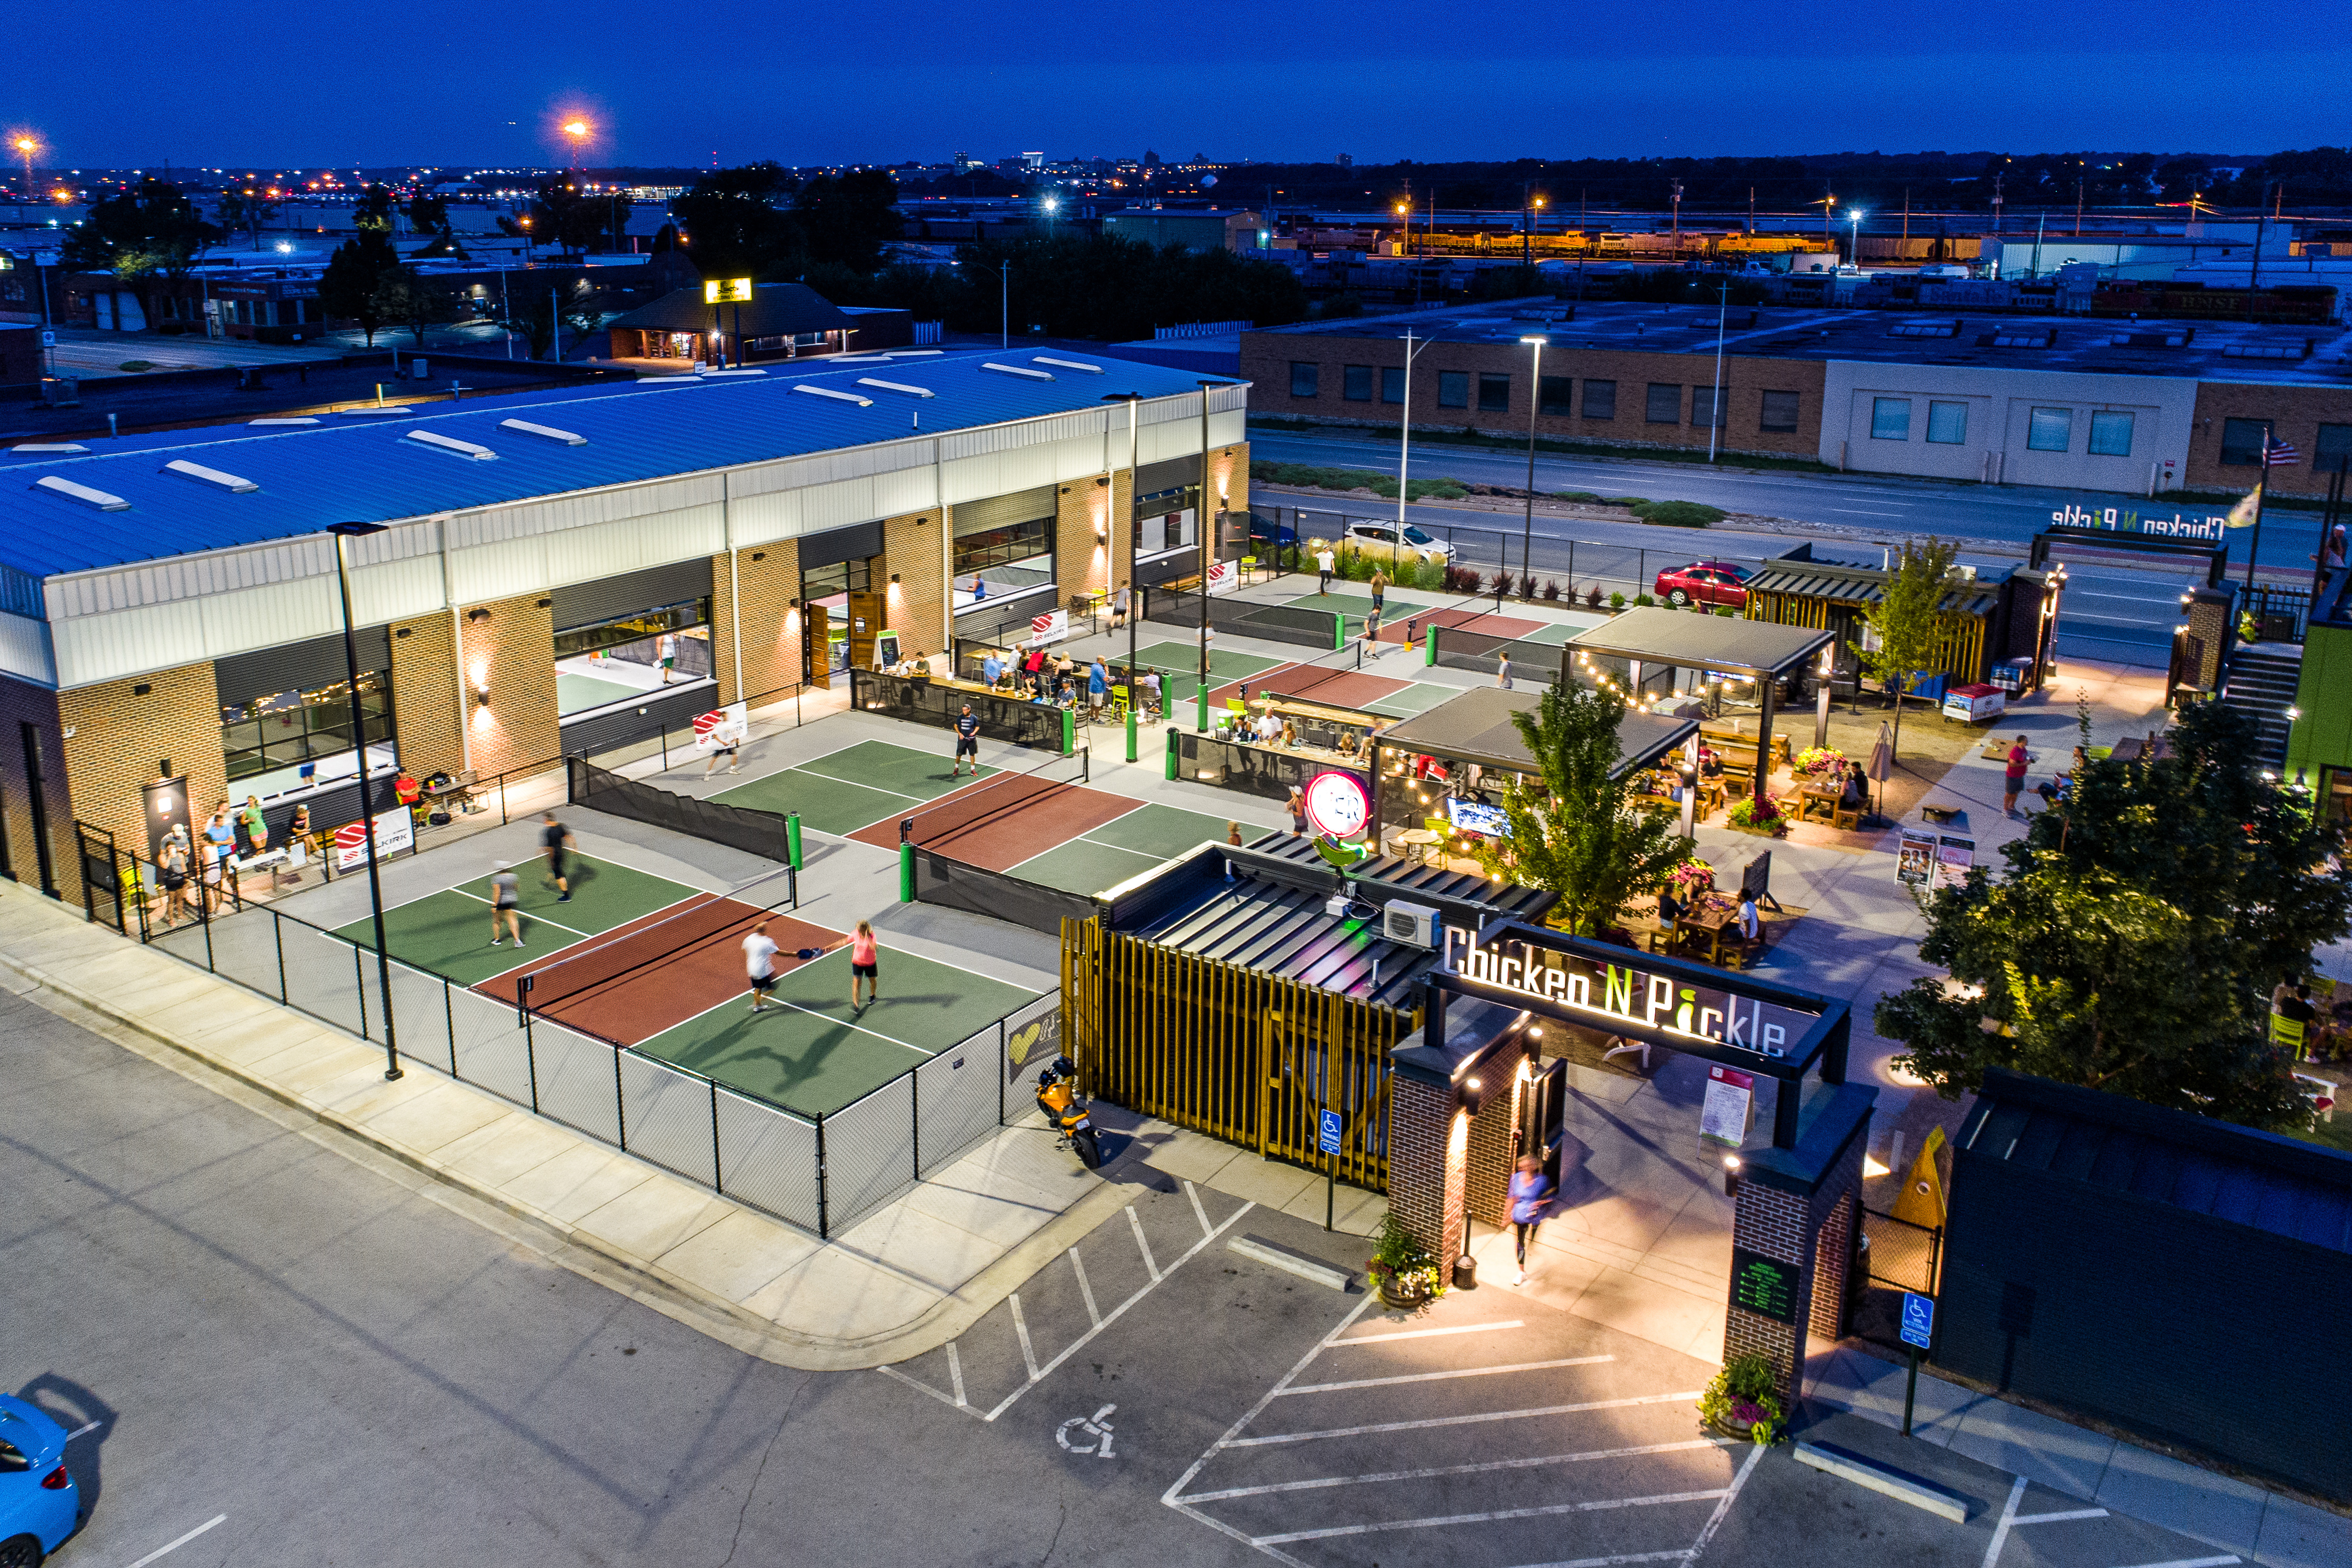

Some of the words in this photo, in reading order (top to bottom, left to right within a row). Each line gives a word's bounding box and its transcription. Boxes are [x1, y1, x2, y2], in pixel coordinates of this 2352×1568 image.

[362, 833, 407, 855] SLKIRK
[1444, 925, 1589, 1006] Chicken
[1605, 964, 1632, 1016] N
[1647, 975, 1786, 1058] Pickle
